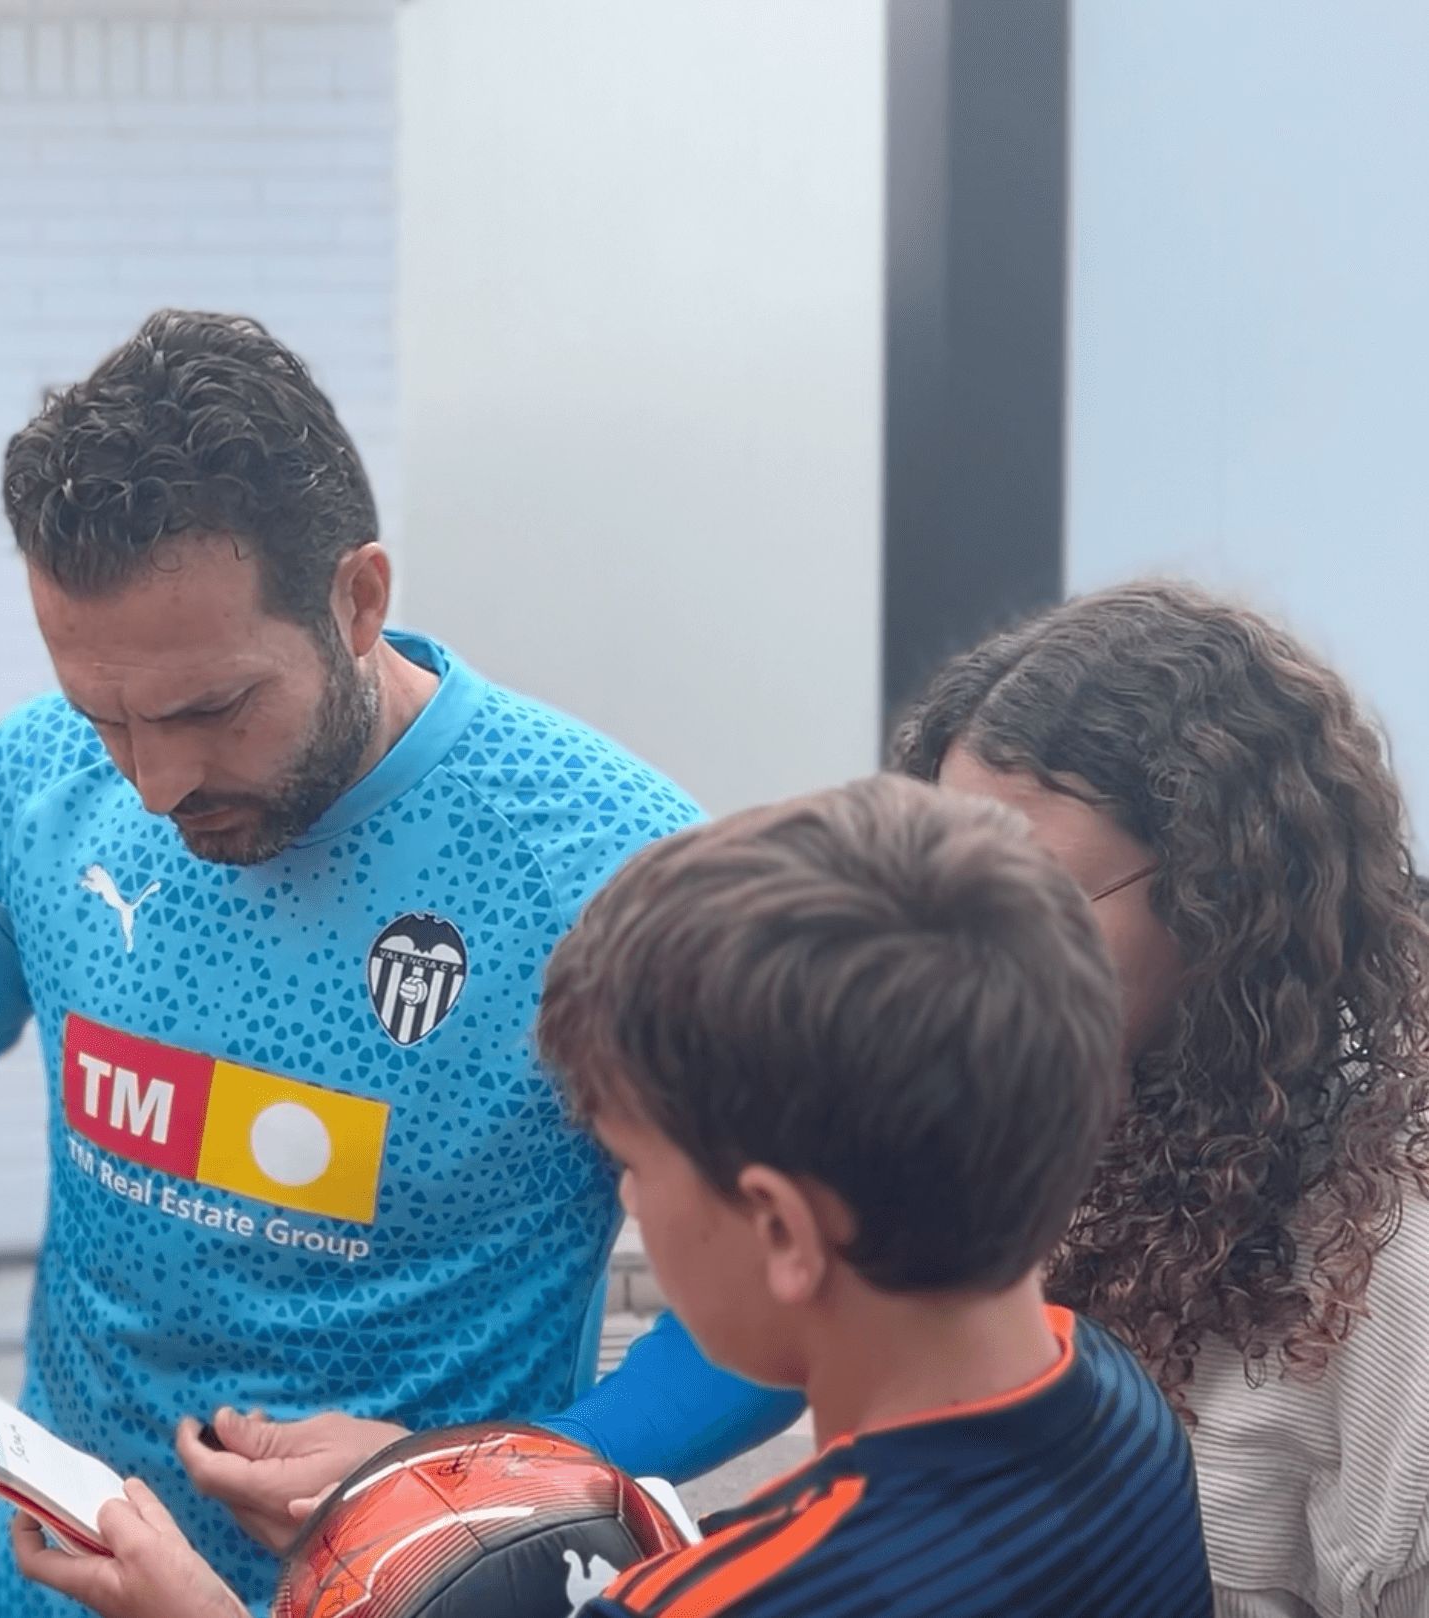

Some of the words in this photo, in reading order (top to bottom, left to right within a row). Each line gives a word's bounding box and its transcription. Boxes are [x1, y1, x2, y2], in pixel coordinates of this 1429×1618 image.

[378, 950, 437, 969] VALENCIA
[77, 1051, 175, 1145] TM
[68, 1135, 94, 1176] TM
[100, 1160, 153, 1206] Real
[161, 1186, 255, 1237] Estate
[265, 1218, 370, 1262] Group
